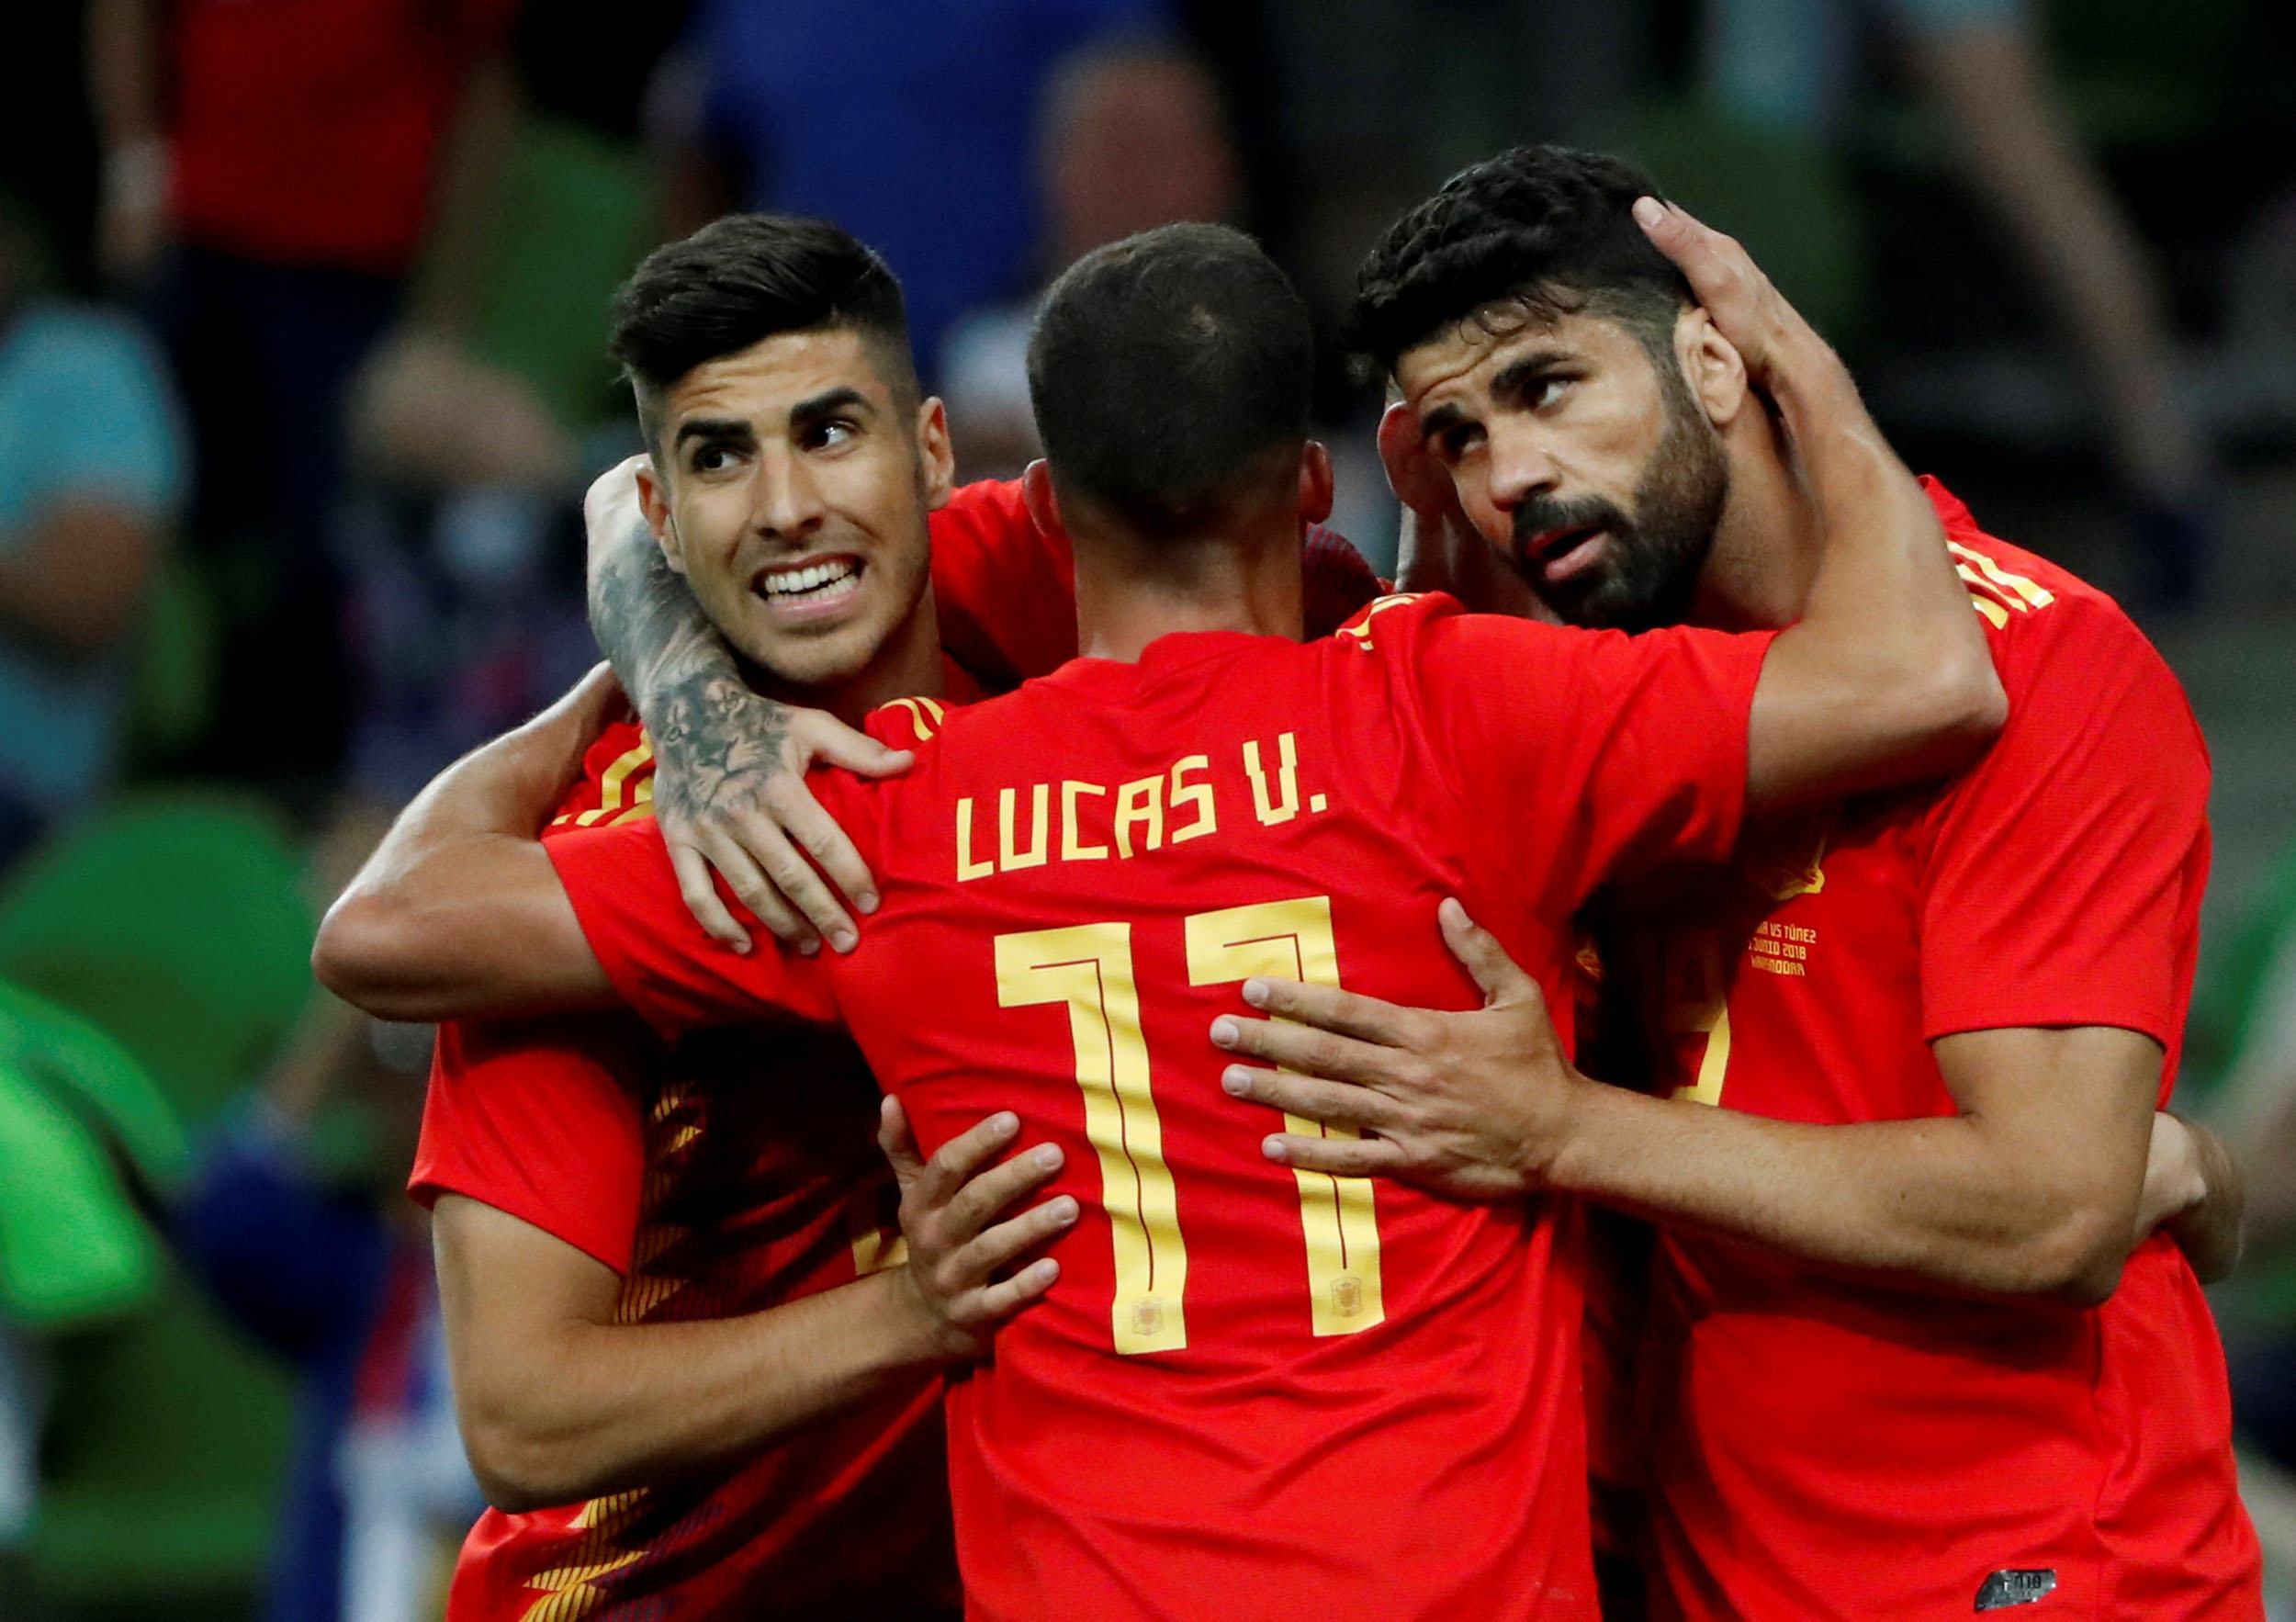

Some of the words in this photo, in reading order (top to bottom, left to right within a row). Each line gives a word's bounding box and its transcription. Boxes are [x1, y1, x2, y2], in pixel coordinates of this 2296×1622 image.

[956, 754, 1217, 883] LUCAS
[1242, 731, 1328, 827] V.
[1783, 943, 1806, 960] 2018
[993, 895, 1386, 1356] 11
